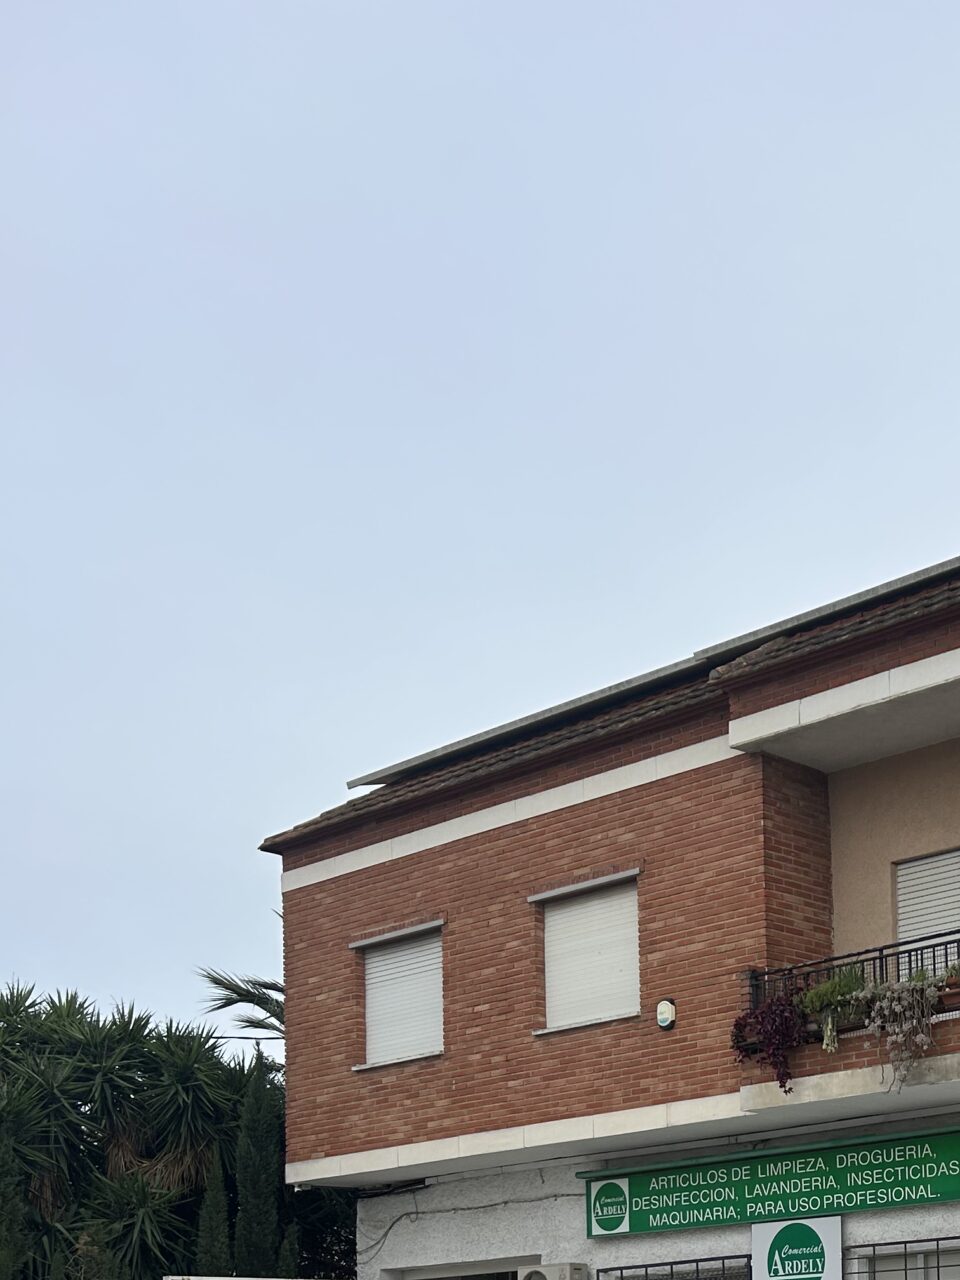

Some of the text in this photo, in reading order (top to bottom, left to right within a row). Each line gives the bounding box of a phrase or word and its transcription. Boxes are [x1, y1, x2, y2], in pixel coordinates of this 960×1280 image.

[649, 1143, 937, 1191] ARTICULOS DE LIMPIEZA, DROGUERIA,
[594, 1200, 627, 1216] ARDELY
[632, 1187, 739, 1211] DESINFECCION,
[745, 1175, 841, 1198] LAVANDERIA,
[649, 1184, 941, 1227] MAQUINARIA; PARA USO PROFESIONAL.
[769, 1249, 825, 1277] ARDELY
[781, 1242, 823, 1258] Comercial
